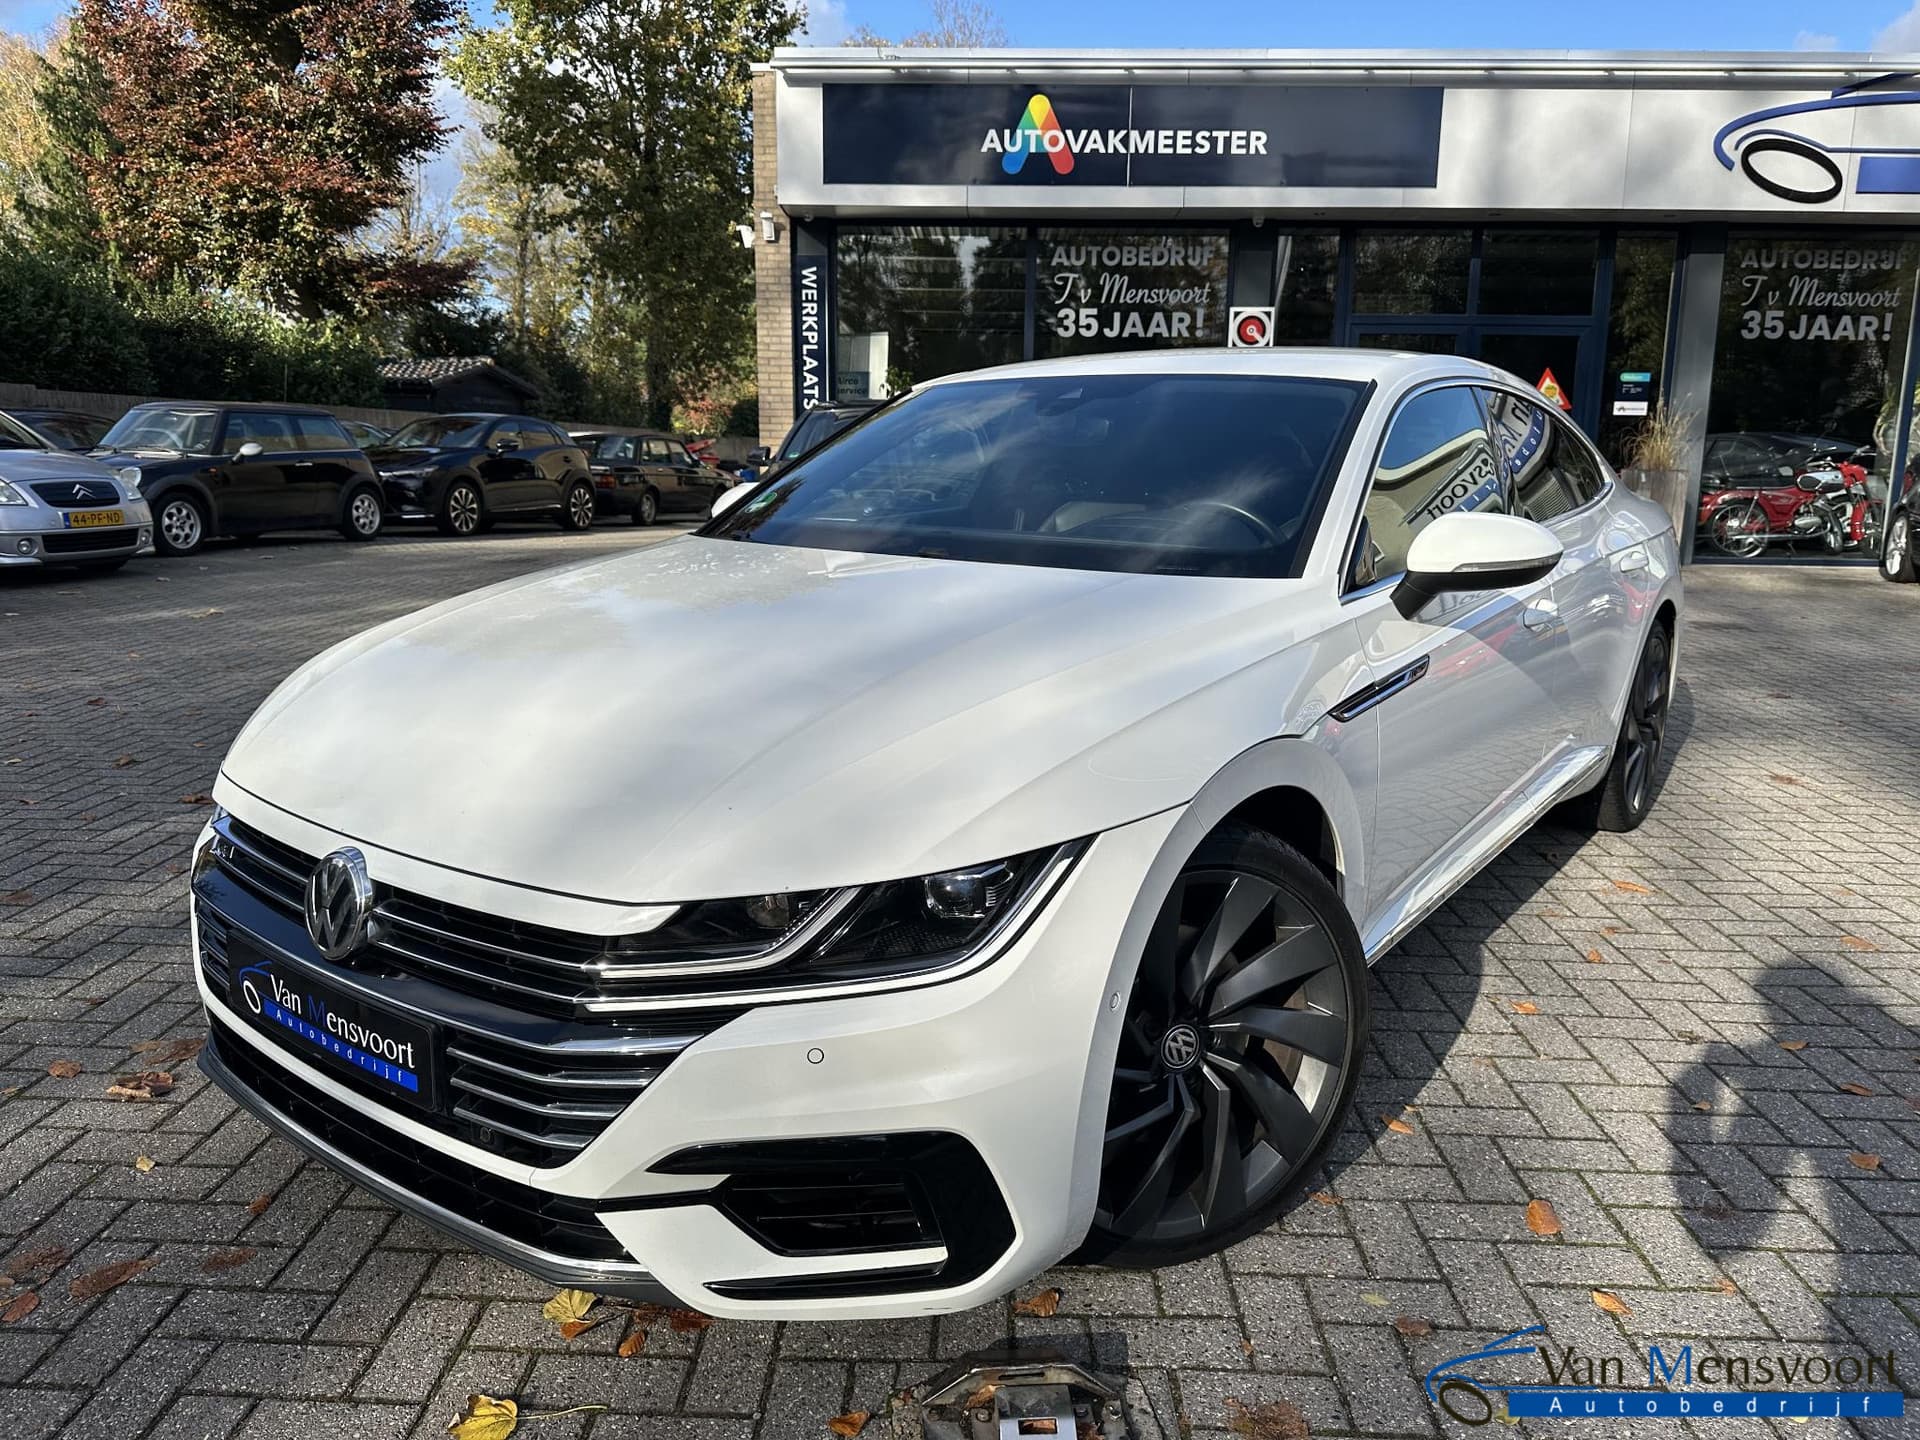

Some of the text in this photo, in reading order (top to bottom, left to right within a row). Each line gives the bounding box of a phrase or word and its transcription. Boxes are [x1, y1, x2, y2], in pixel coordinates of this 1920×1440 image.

[980, 129, 1268, 155] AUTOVAKMEESTER
[1051, 246, 1214, 267] AUTOBEDRIJF
[1054, 272, 1211, 304] T v Mensvoort
[1740, 275, 1902, 308] T v Mensvoort
[801, 266, 819, 410] WERKPLAATS
[1057, 307, 1205, 338] 35 JAAR!
[1740, 310, 1893, 341] 35 JAAR!
[270, 974, 415, 1069] Van Mensvoort
[276, 1009, 403, 1082] Autobedrijf
